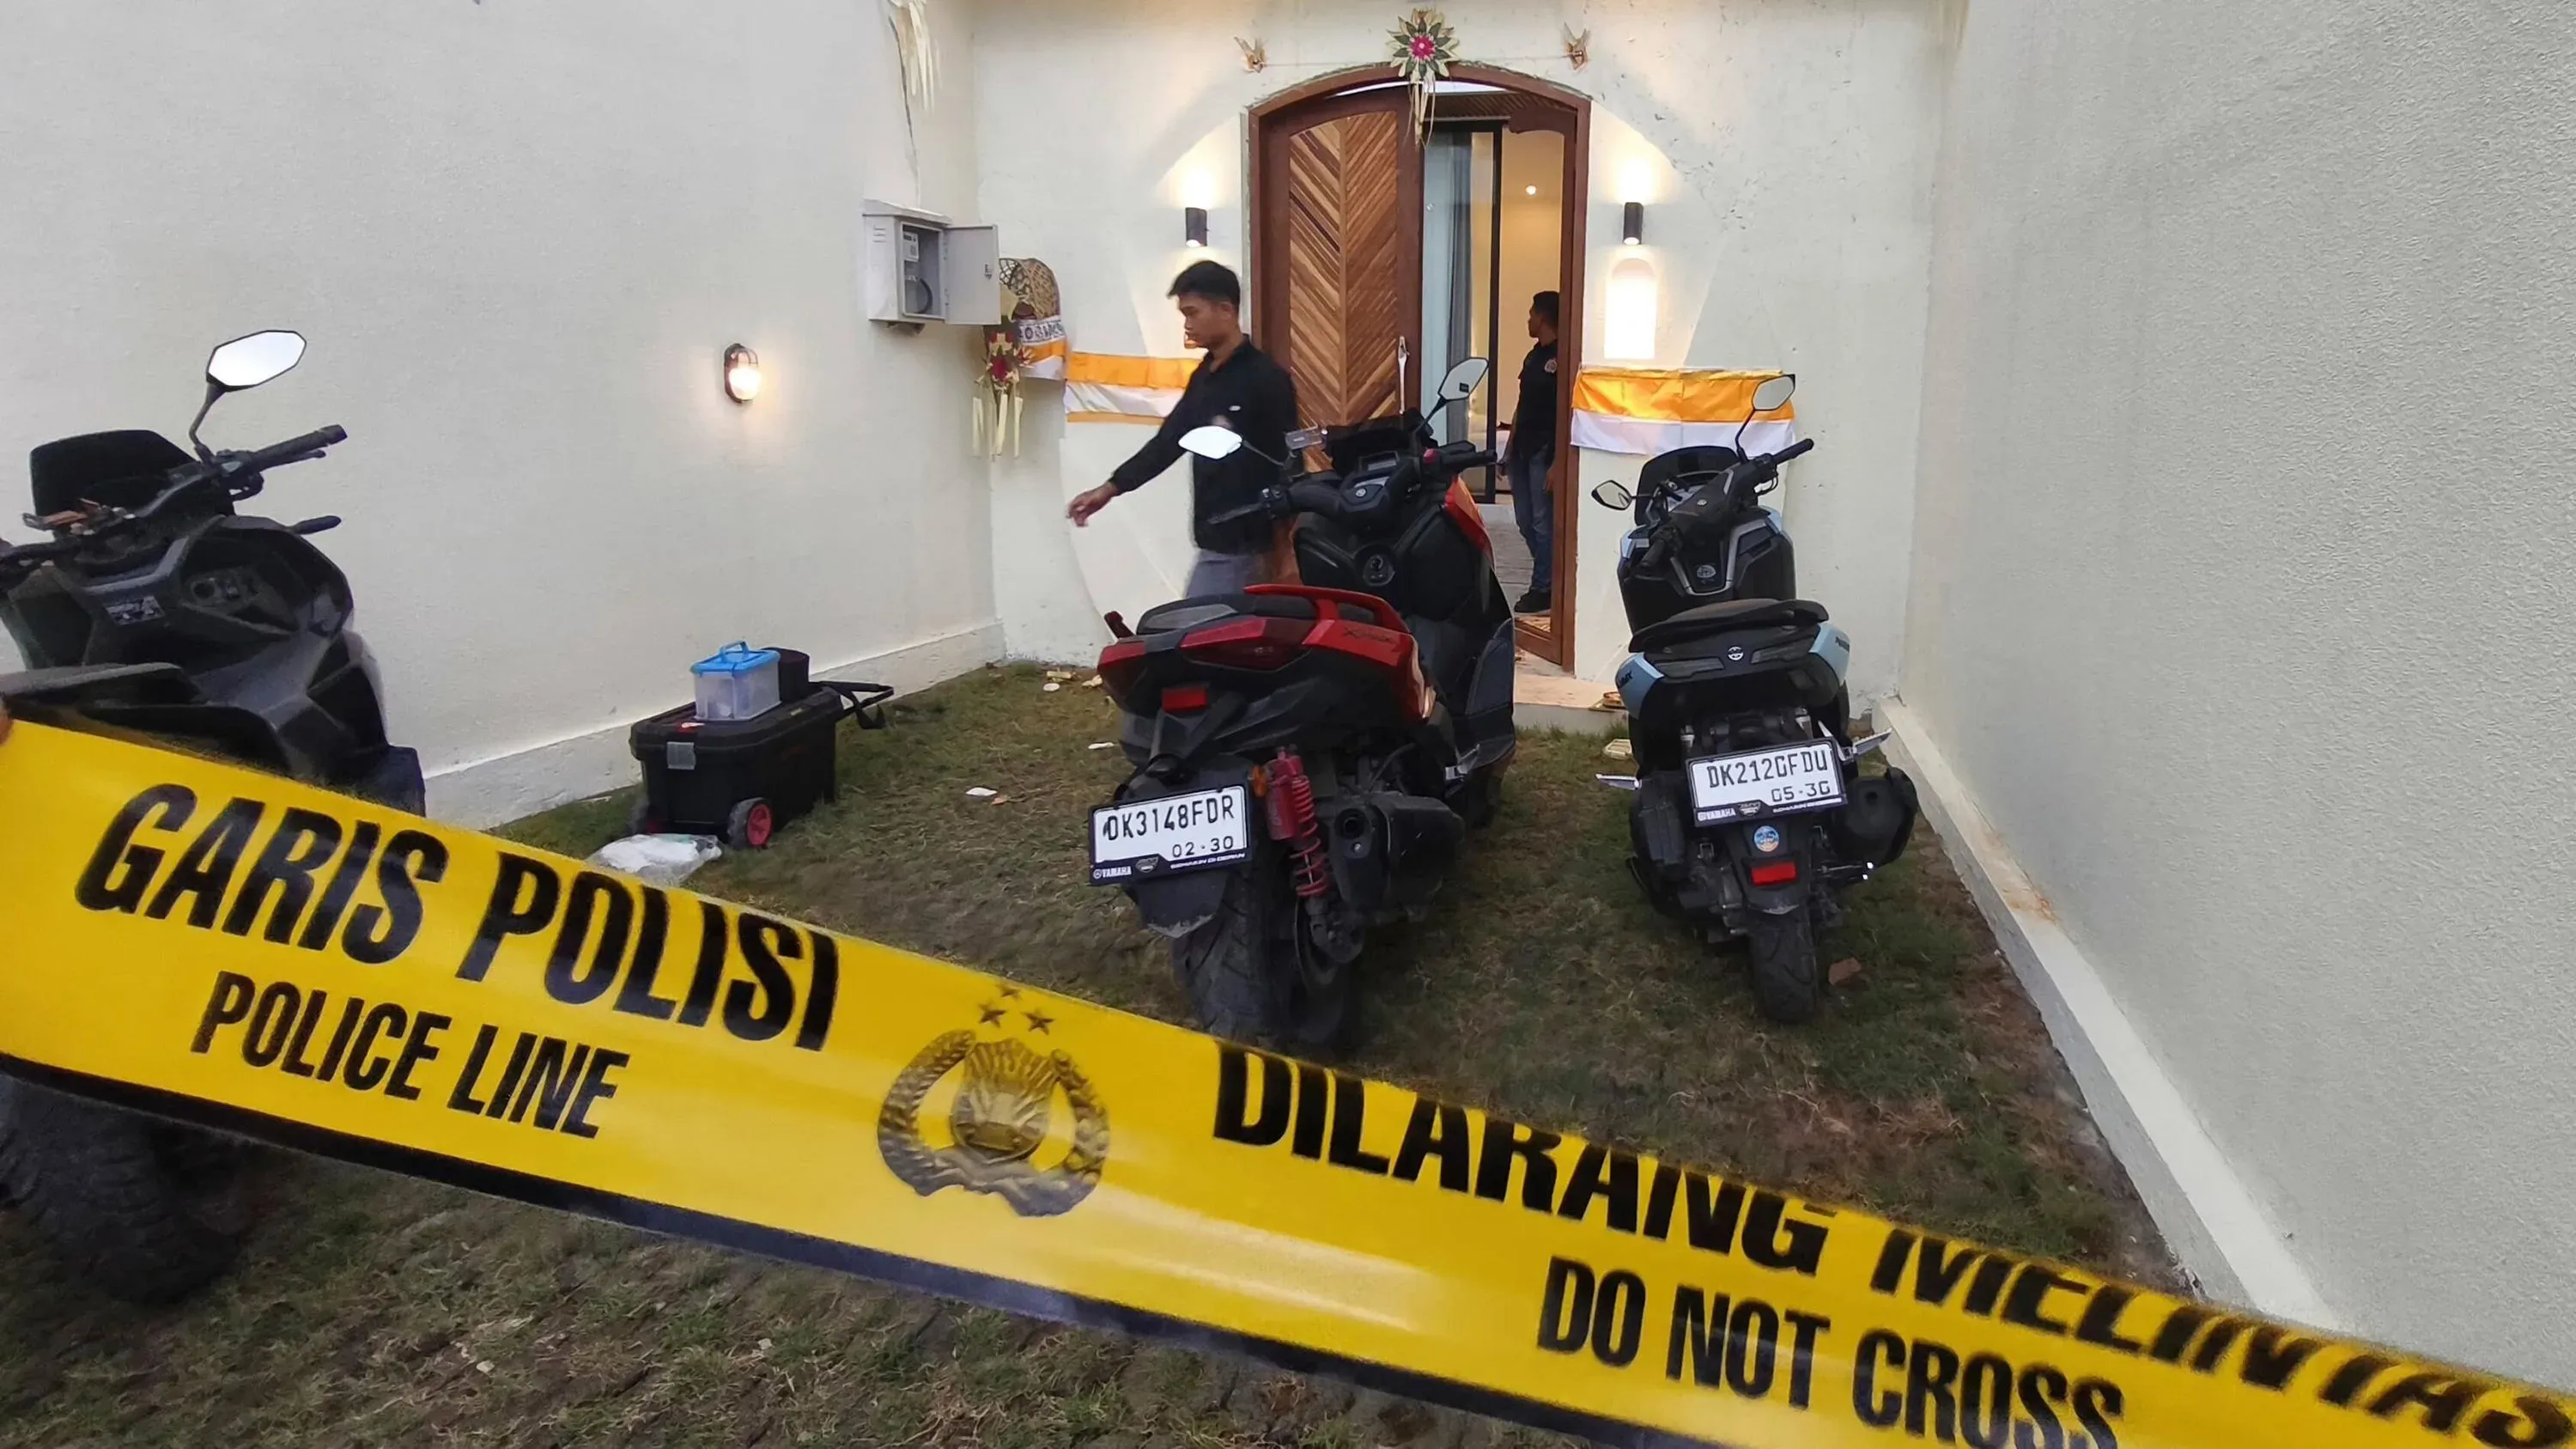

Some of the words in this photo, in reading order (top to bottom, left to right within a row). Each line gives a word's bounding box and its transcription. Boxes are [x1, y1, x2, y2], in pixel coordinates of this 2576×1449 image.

[1102, 866, 1132, 879] YAMAHA
[1107, 795, 1234, 841] DK3148FDR
[75, 783, 449, 965] GARIS
[455, 852, 839, 1051] POLISI
[190, 971, 452, 1101] POLICE
[447, 1024, 630, 1138] LINE
[1212, 1041, 1836, 1276] DILARANG
[1536, 1256, 1646, 1367] DO
[1665, 1284, 1831, 1410] NOT
[1852, 1328, 2125, 1449] CROSS
